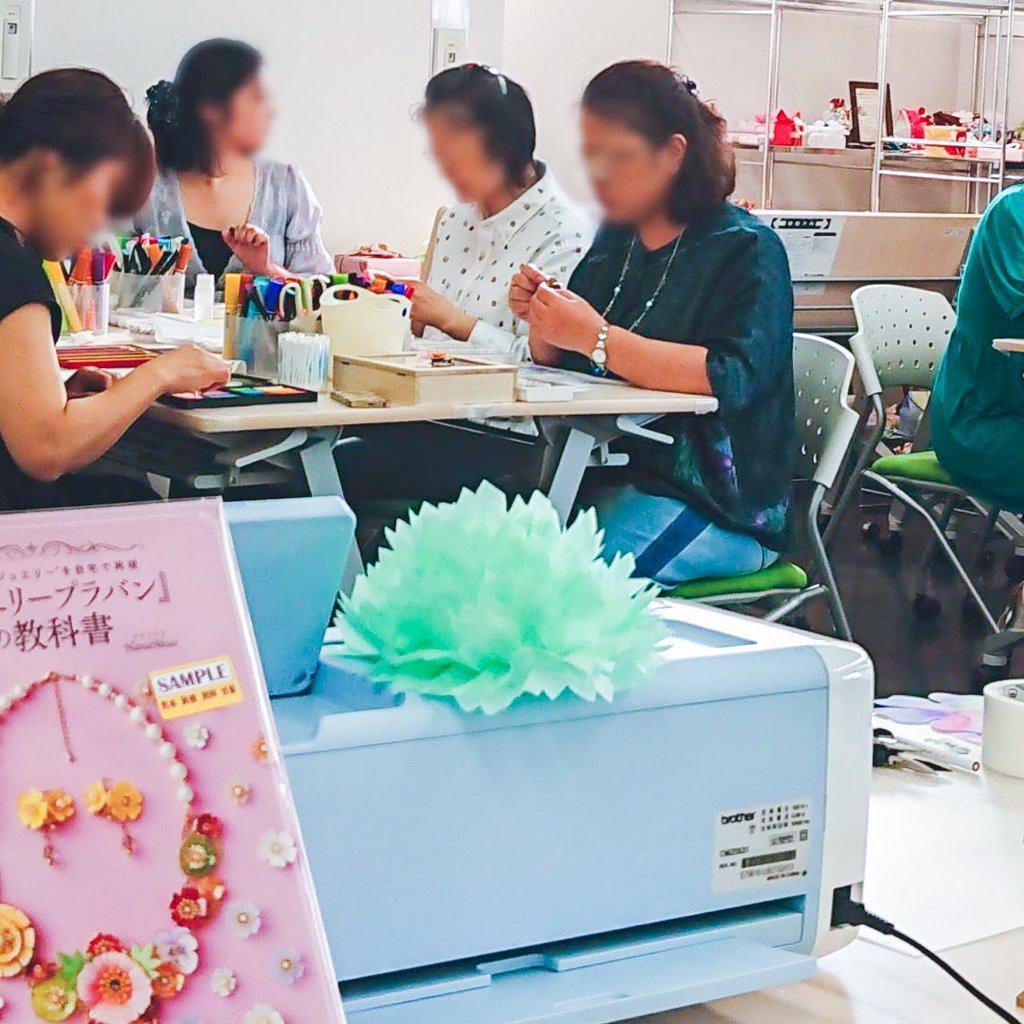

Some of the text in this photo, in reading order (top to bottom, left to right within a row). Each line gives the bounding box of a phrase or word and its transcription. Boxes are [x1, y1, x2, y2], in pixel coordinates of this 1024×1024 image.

[0, 570, 171, 617] リープラバン』
[157, 662, 230, 694] SAMPLE
